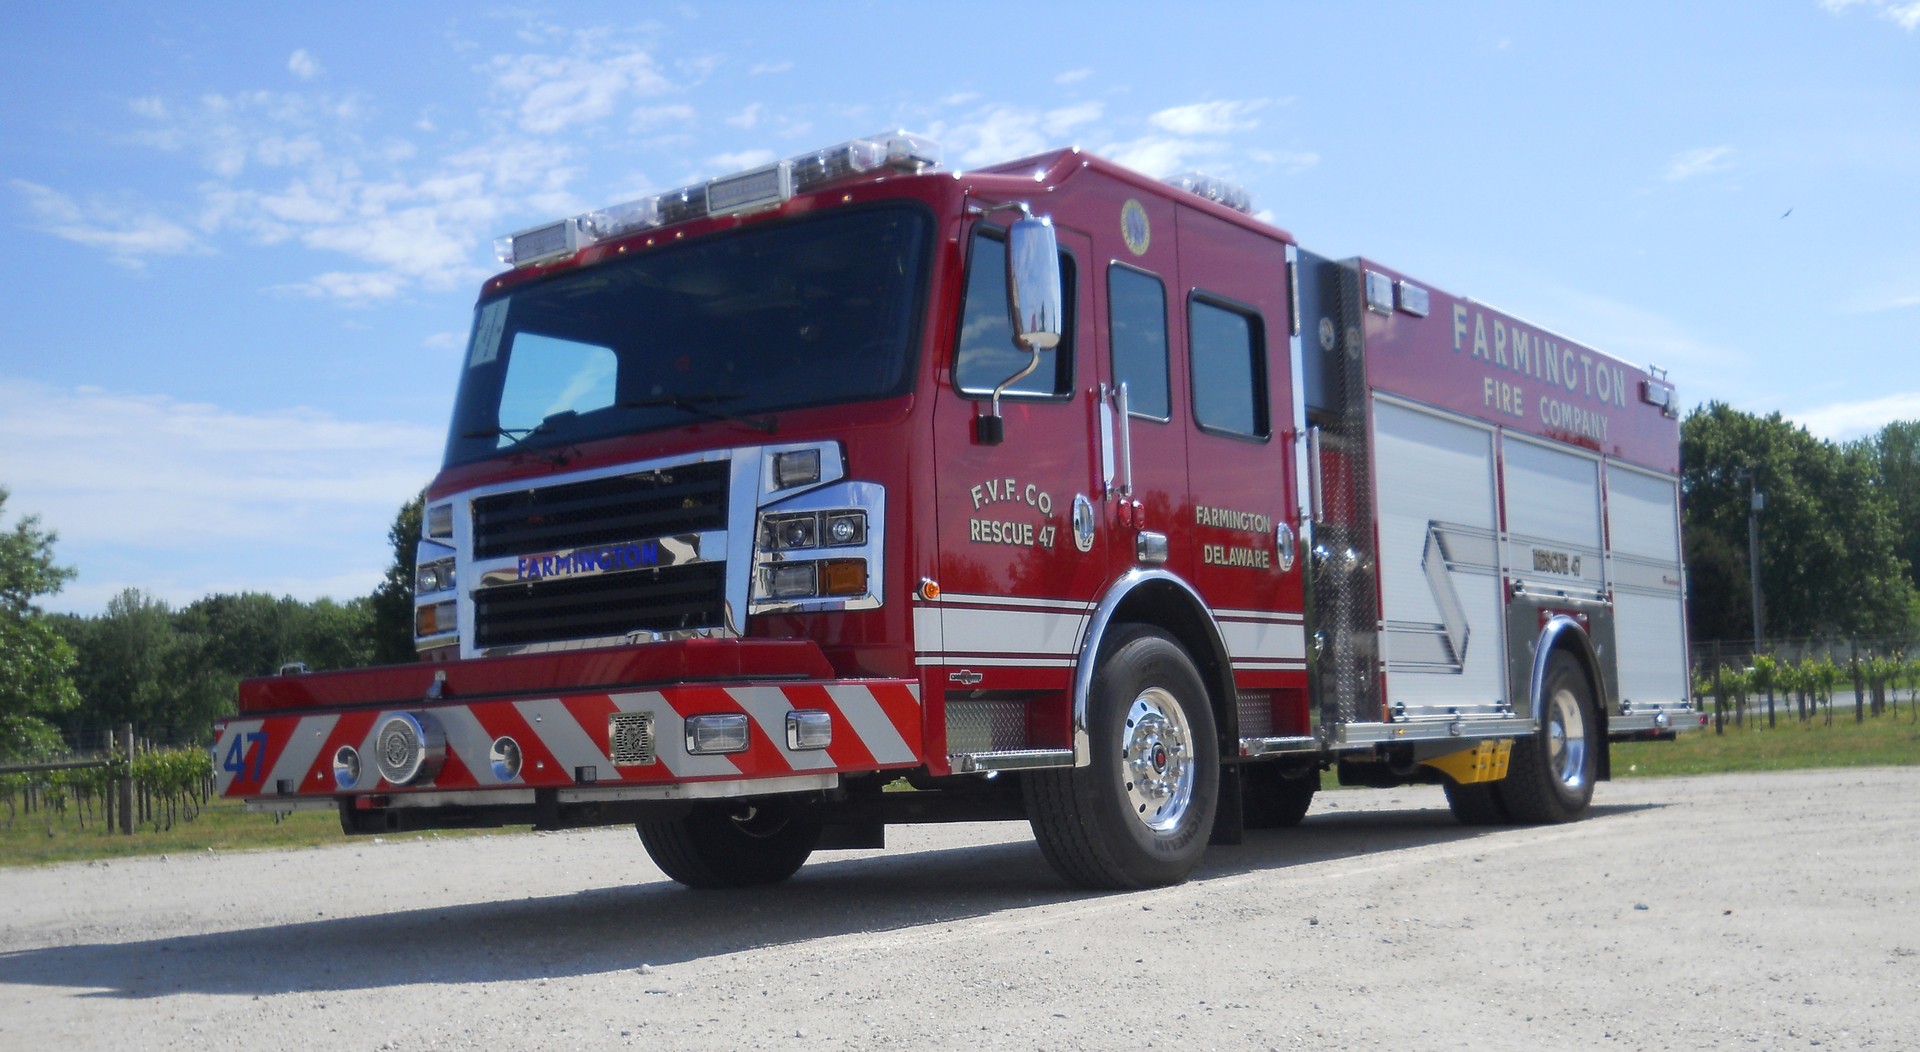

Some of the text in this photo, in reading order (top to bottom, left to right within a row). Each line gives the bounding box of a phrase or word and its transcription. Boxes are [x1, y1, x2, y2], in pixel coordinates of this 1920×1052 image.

[1453, 303, 1627, 408] FARMINGTON
[1483, 376, 1609, 442] FIRE COMPANY
[970, 478, 1021, 510] F.V.F.
[970, 518, 1056, 547] RESCUE 47
[1195, 505, 1271, 533] FARMINGTON
[517, 542, 658, 582] FARMINGTON
[1203, 544, 1270, 569] DELAWARE
[1533, 549, 1581, 577] RESCUE 47
[223, 730, 269, 785] 47
